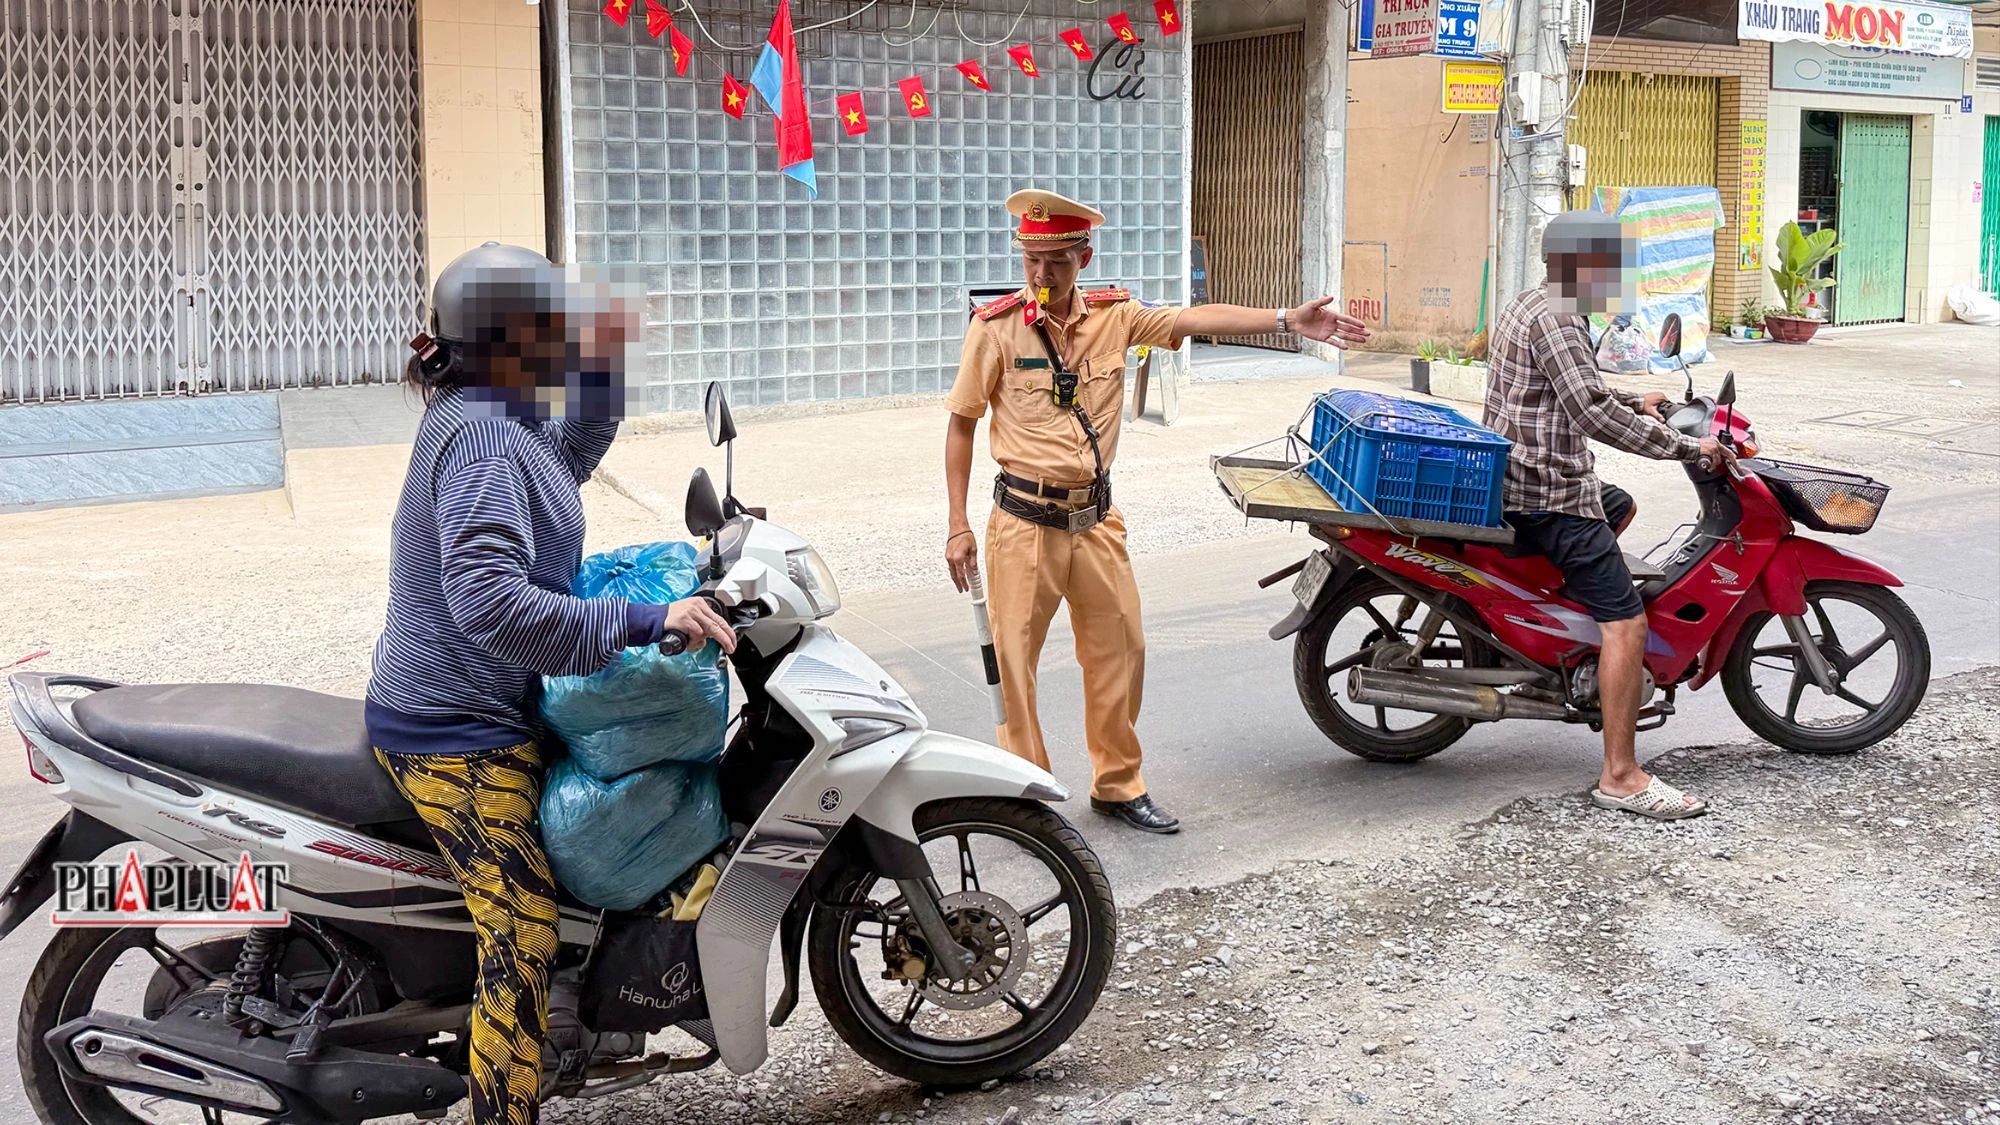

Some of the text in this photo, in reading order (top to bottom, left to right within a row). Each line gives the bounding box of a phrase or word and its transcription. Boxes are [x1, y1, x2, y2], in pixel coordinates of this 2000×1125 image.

[1457, 3, 1477, 13] XUÂN
[1375, 23, 1392, 38] GIA
[1438, 17, 1477, 38] M 9
[1781, 6, 1821, 35] TRANG
[1824, 2, 1906, 47] MON
[1385, 541, 1466, 573] Wave
[618, 984, 691, 1010] Hanwha
